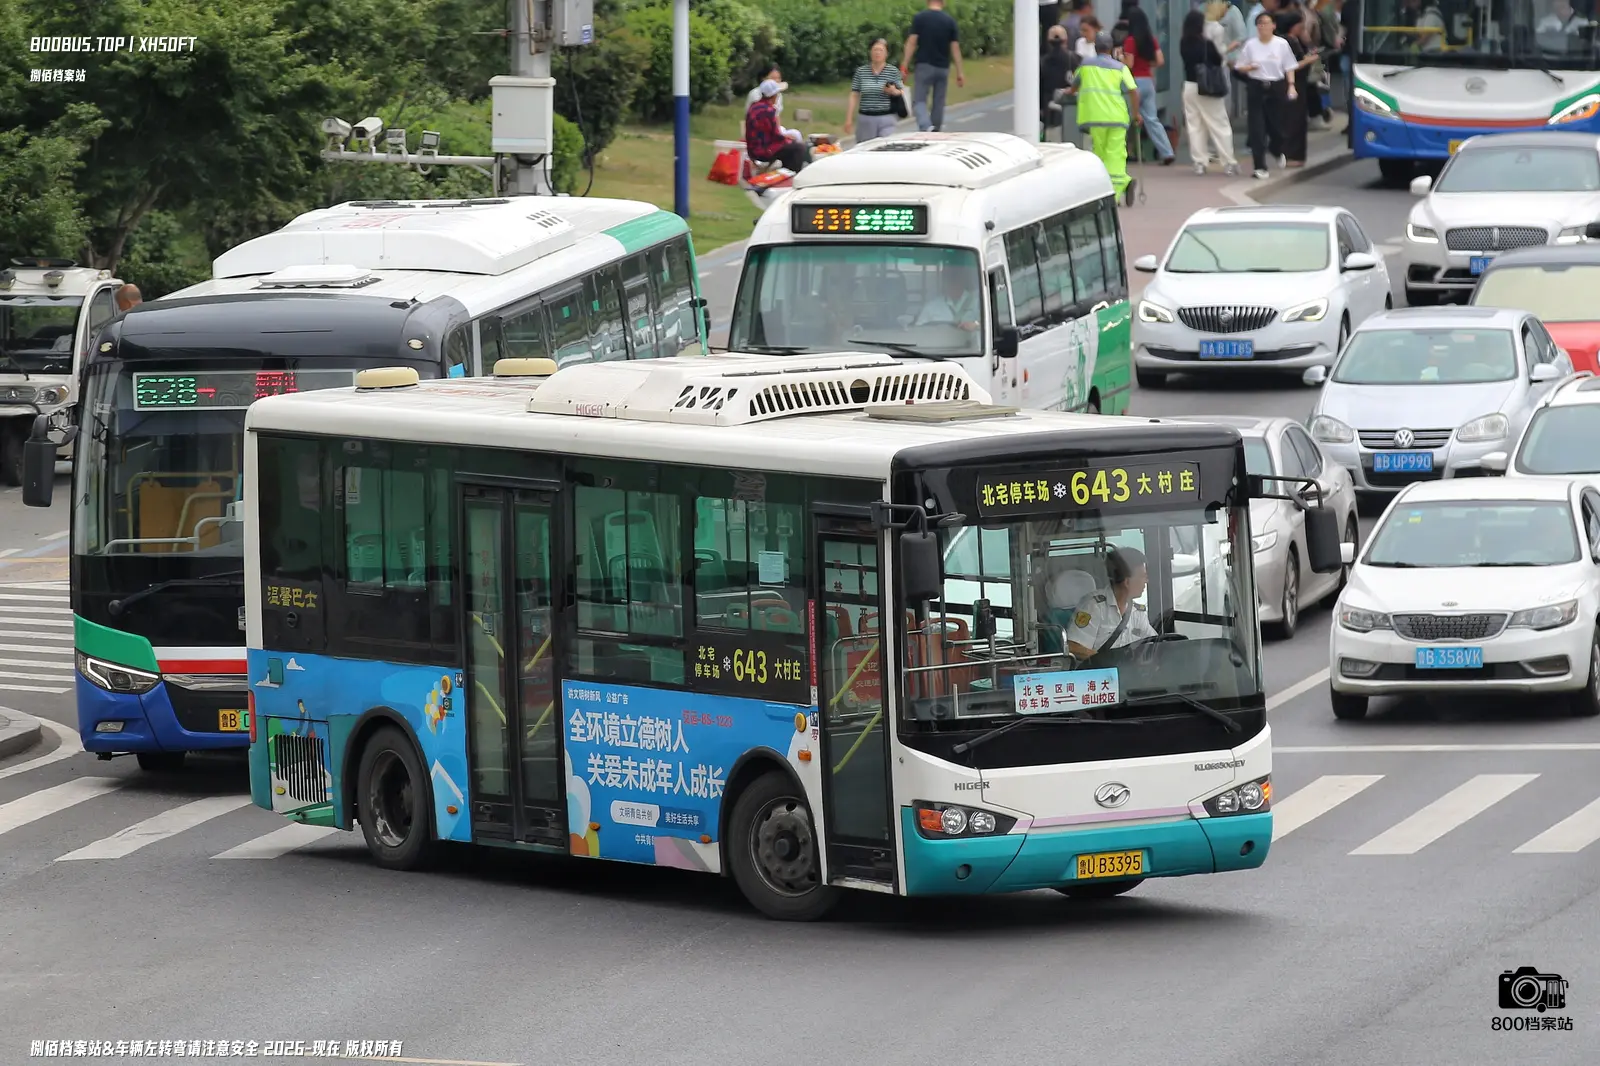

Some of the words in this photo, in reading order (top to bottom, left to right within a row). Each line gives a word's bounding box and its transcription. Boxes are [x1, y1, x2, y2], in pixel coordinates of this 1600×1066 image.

[812, 209, 851, 231] 431
[138, 377, 198, 405] 628
[576, 403, 604, 416] HIGER
[981, 479, 1050, 507] 北宅停车场
[1071, 468, 1132, 505] 643
[1136, 469, 1195, 496] 大村庄
[267, 585, 318, 608] 温馨巴士
[698, 645, 715, 660] 北宅
[694, 662, 720, 679] 停车场
[733, 648, 768, 684] 643
[774, 657, 801, 680] 大村庄
[567, 687, 601, 703] 讲文明树新风
[606, 692, 629, 705] 公益广告
[1023, 684, 1044, 697] 北宅
[1055, 682, 1075, 694] 区间
[1087, 680, 1110, 692] 海大
[1019, 697, 1050, 711] 停车场
[1081, 692, 1116, 705] 崂山校区
[569, 708, 690, 754] 全环境立德树人
[587, 752, 726, 800] 关爱未成年人成长
[954, 780, 991, 791] HIGER
[619, 806, 653, 822] 文明青岛共创
[665, 811, 700, 827] 美好生活共享
